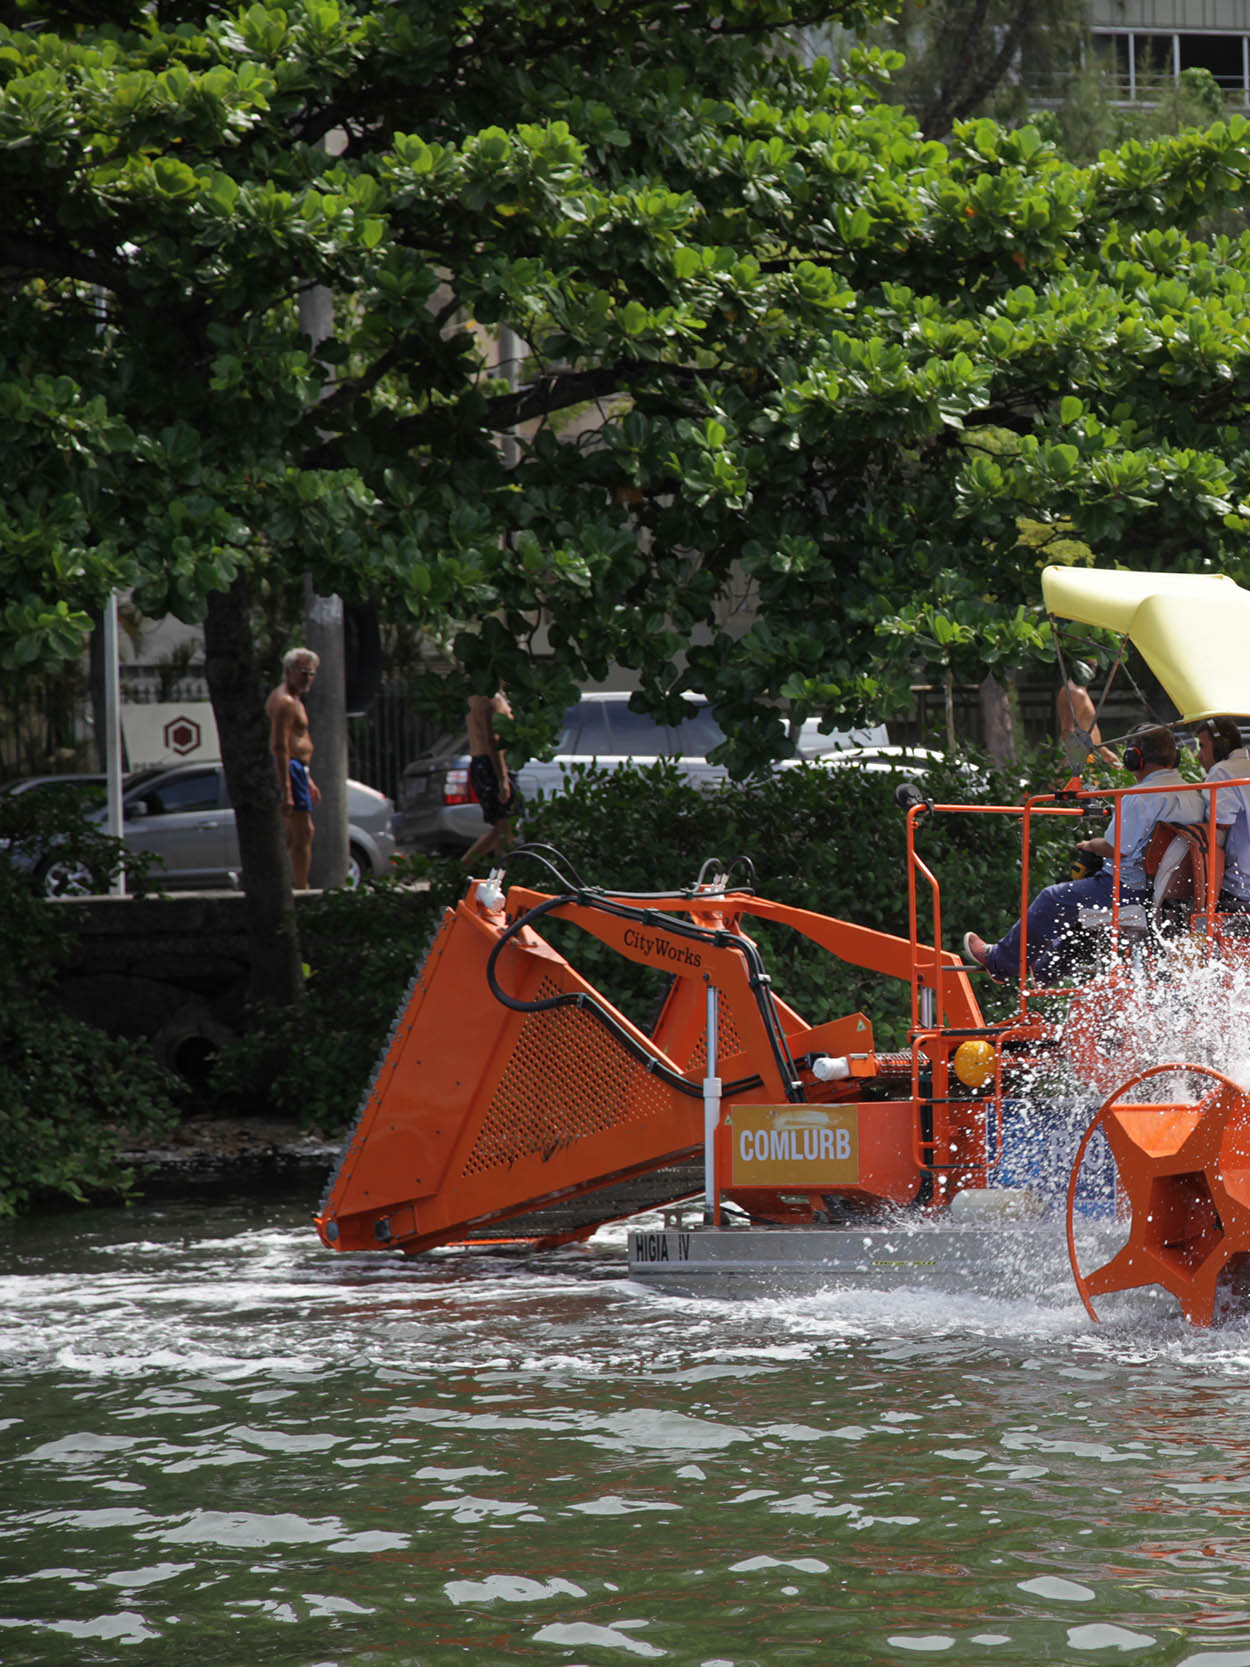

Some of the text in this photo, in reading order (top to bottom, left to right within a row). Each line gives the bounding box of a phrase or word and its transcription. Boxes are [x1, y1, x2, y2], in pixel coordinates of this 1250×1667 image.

[623, 928, 702, 968] CityWorks
[740, 1128, 852, 1162] COMLURB
[635, 1233, 691, 1262] HIGIA IV
